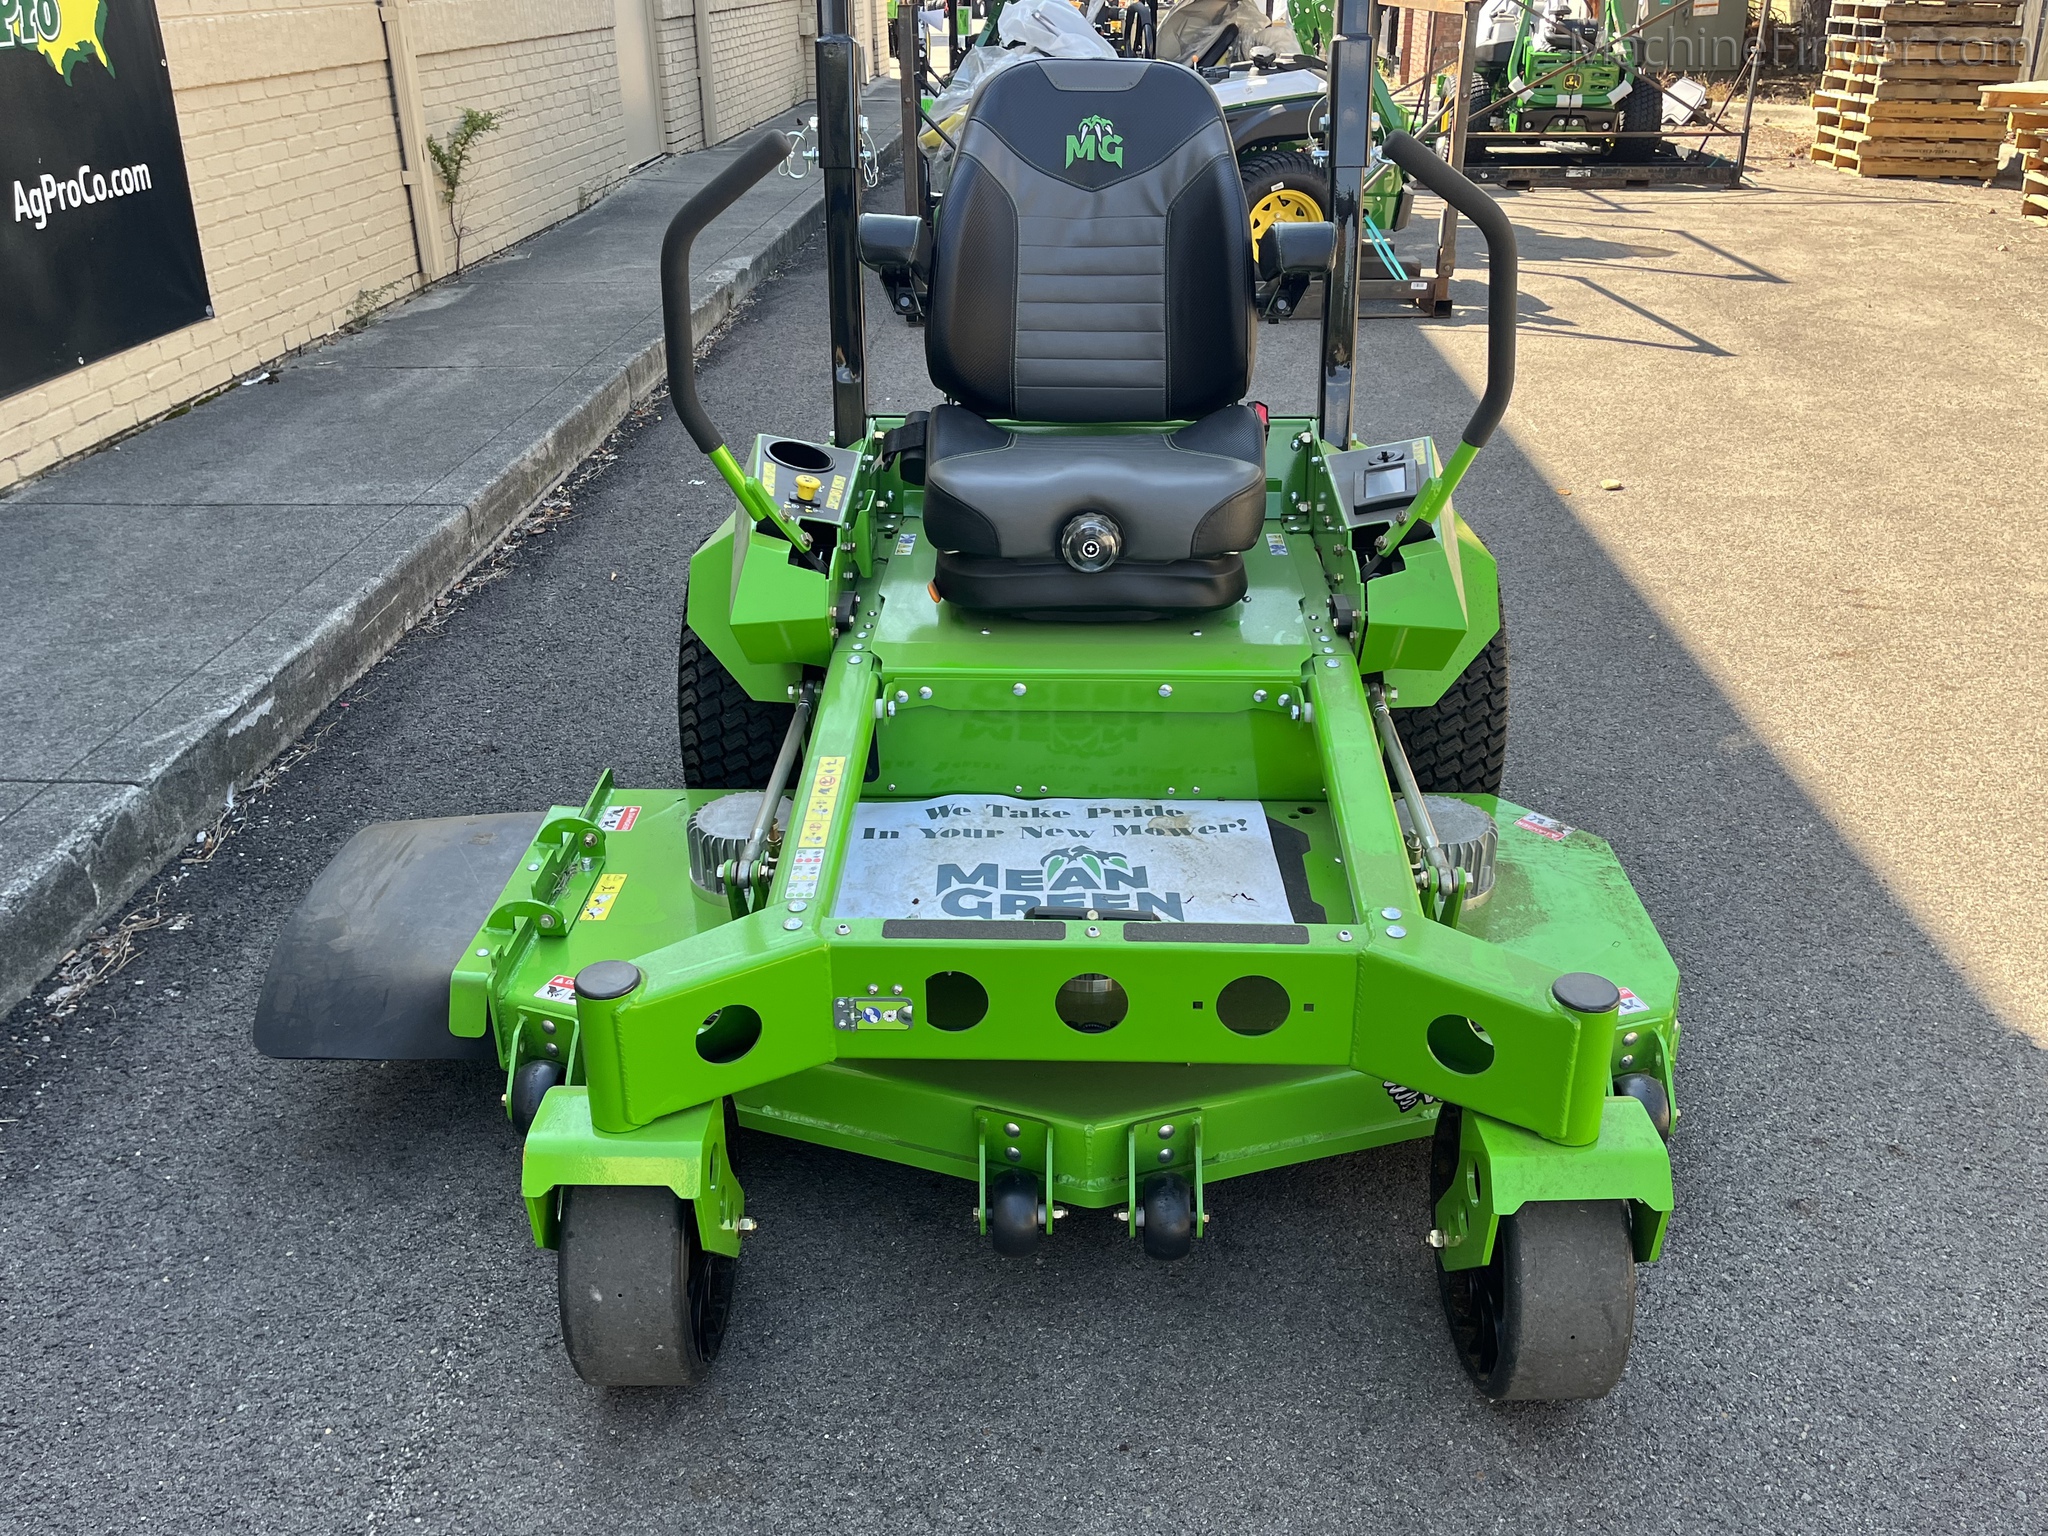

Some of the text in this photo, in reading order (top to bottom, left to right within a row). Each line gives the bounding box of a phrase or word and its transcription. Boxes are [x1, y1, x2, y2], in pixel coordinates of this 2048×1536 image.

[1065, 134, 1124, 169] MG
[13, 163, 152, 230] AgProCo.com
[925, 803, 1184, 820] We Take Pride
[863, 819, 1248, 840] In Your New Mower!
[936, 863, 1149, 896] MEAN
[941, 888, 1185, 922] GREEN
